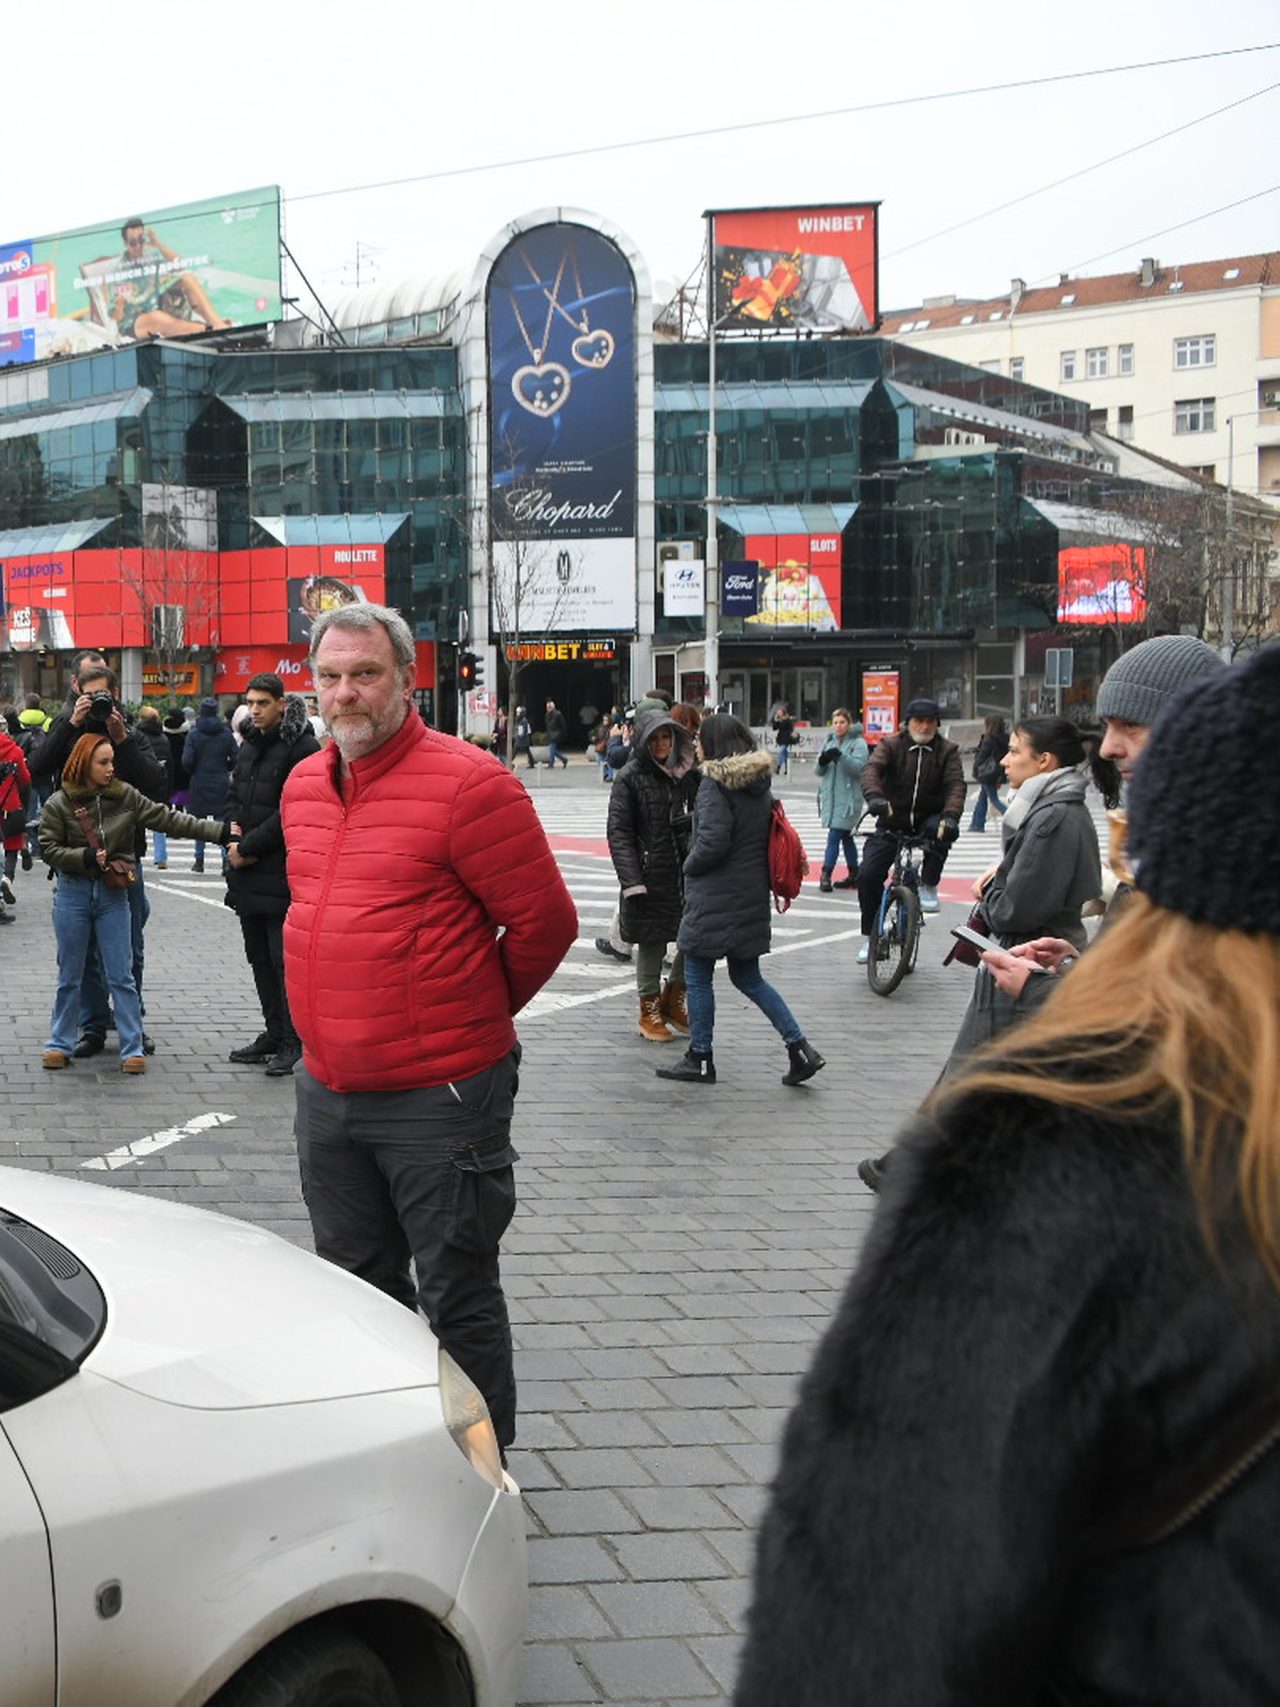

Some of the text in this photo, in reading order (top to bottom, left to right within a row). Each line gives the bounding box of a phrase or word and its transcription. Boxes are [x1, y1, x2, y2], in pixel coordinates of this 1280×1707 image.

[797, 215, 865, 233] WINBET
[144, 264, 157, 275] за
[505, 488, 623, 527] Chopard
[810, 539, 837, 552] SLOTS
[334, 550, 377, 563] ROULETTE
[11, 562, 64, 579] JACKPOTS
[725, 574, 754, 590] Ford
[507, 643, 581, 661] WINBET
[274, 659, 301, 675] Mo
